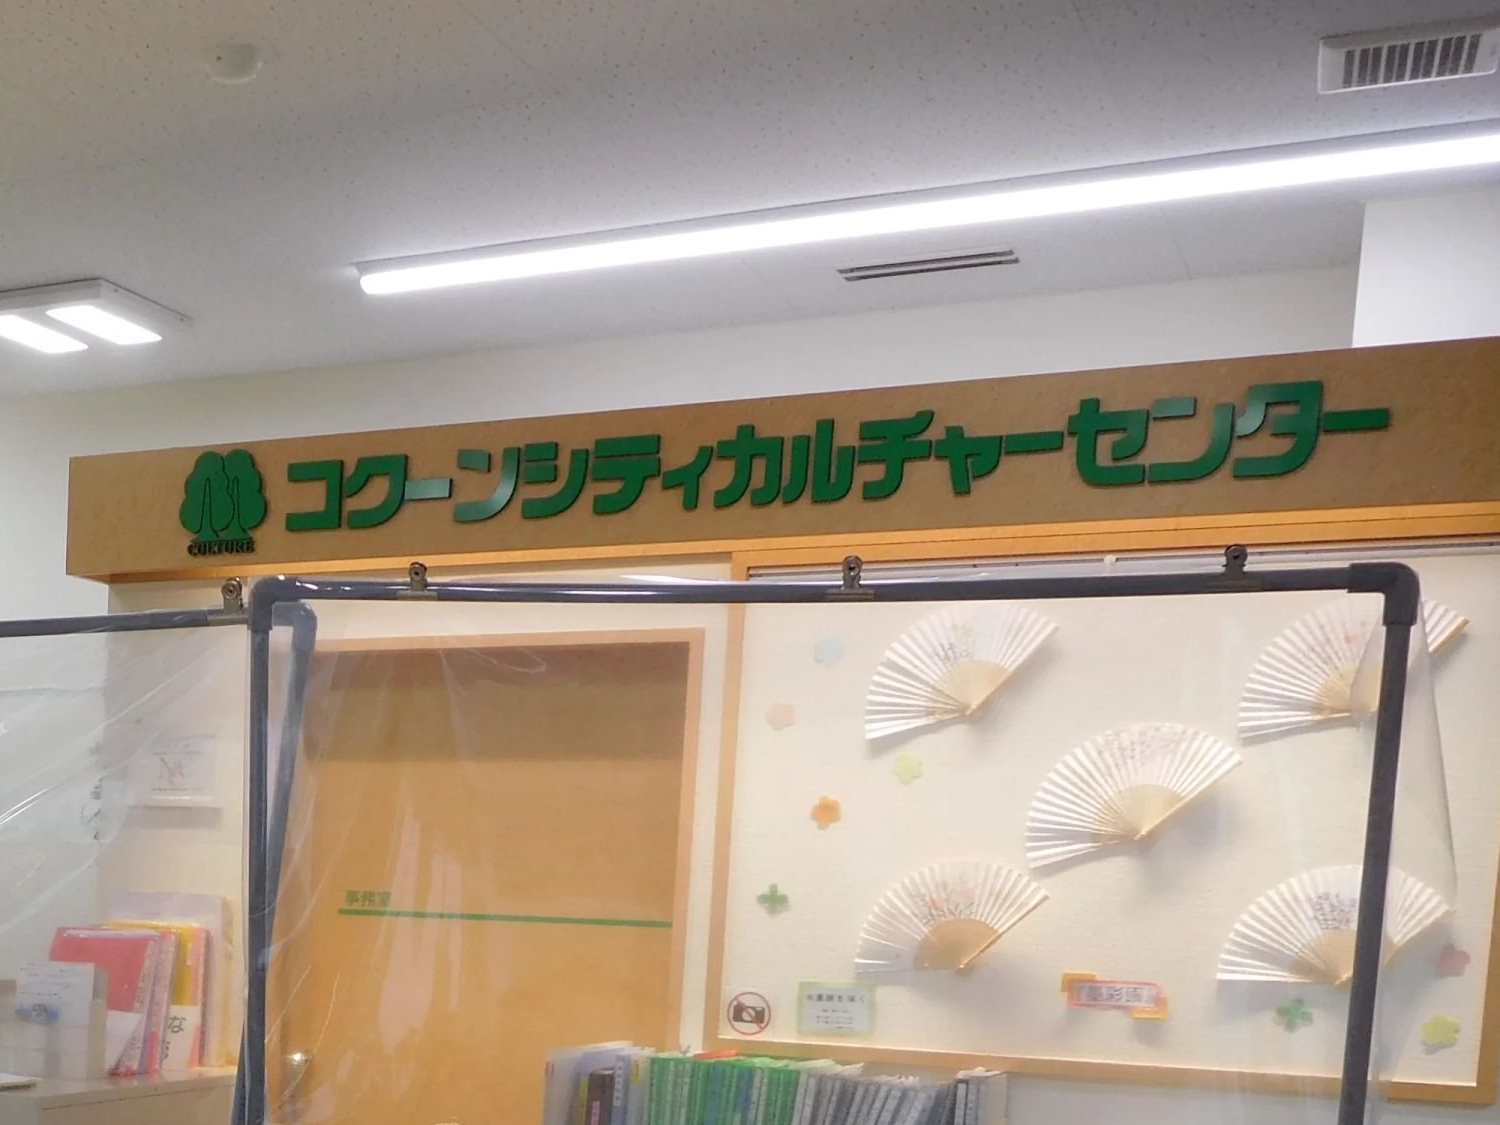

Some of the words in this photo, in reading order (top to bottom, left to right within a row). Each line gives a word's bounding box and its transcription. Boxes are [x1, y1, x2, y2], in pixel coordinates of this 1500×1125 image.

[285, 379, 1390, 532] コクーンシティカルチャーセンター
[186, 539, 256, 556] CULTURE
